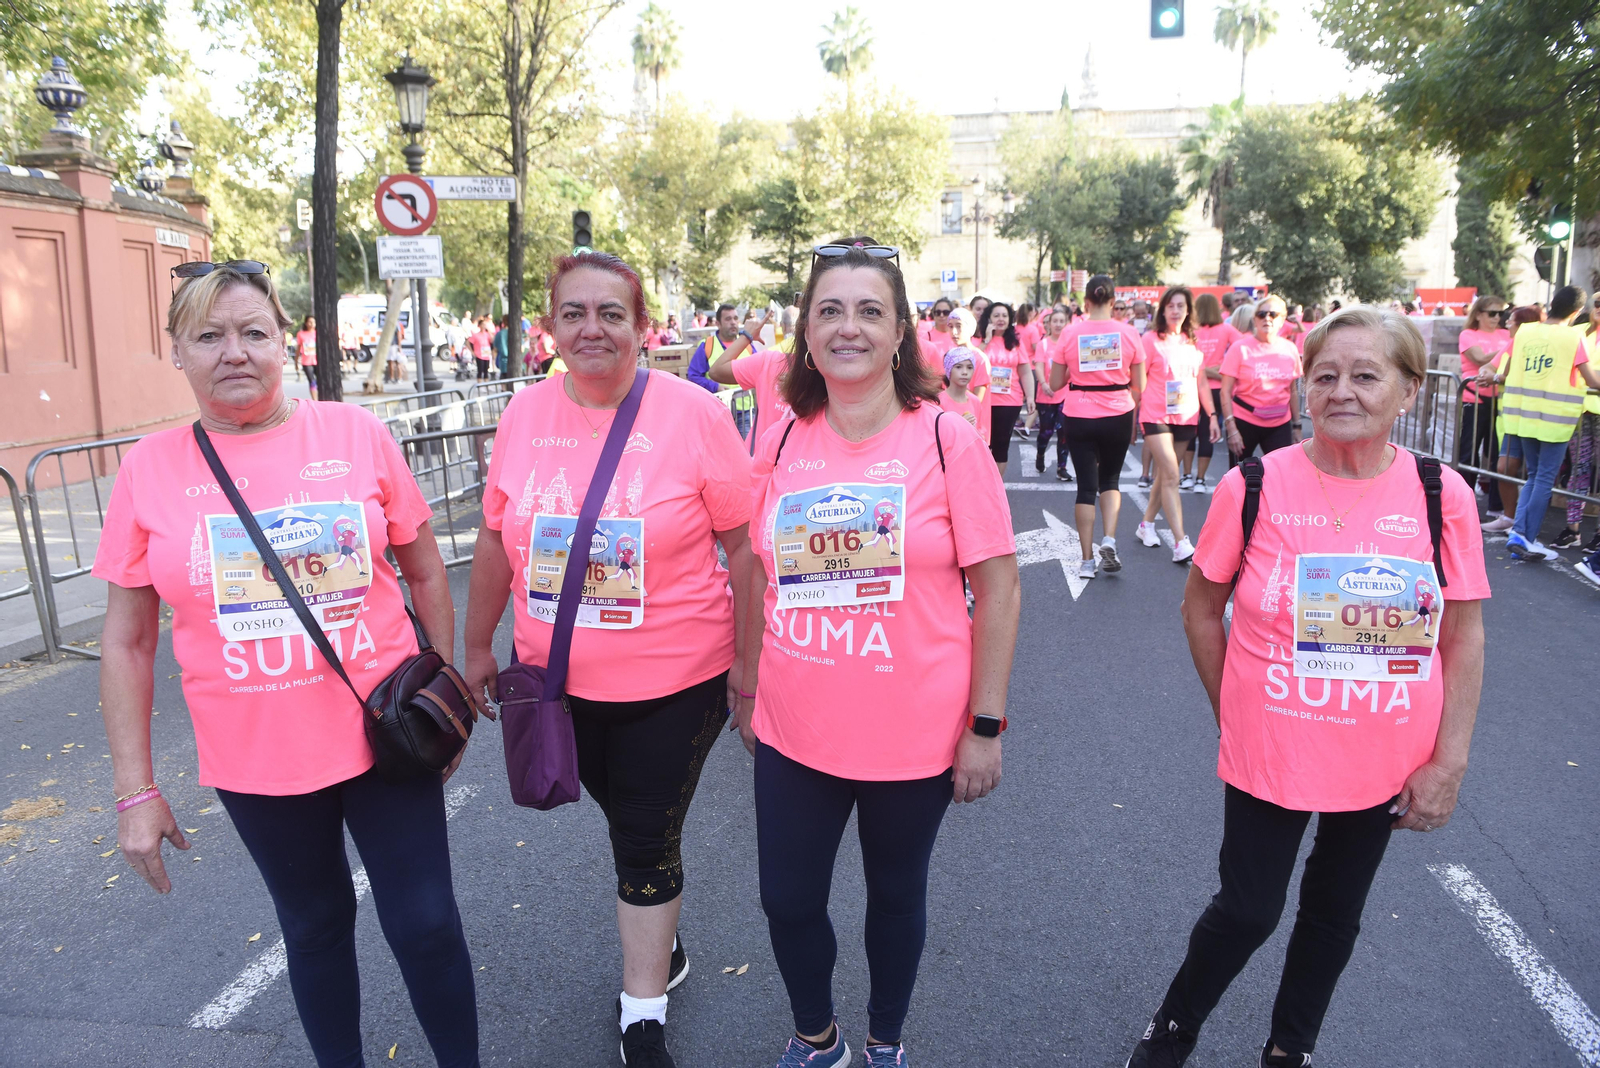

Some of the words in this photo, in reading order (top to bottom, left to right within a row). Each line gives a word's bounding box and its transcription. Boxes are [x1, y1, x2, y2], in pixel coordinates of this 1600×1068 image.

[481, 178, 510, 186] HOTEL
[944, 271, 954, 282] P
[1525, 355, 1553, 373] Life
[532, 436, 578, 448] OYSHO
[304, 465, 349, 478] ASTURIANA
[186, 477, 249, 497] OYSO
[783, 508, 802, 516] SUMA
[810, 507, 861, 519] ASTURIANA
[1271, 513, 1327, 527] OYSHO
[1378, 523, 1417, 534] ASTURIAN
[269, 528, 319, 545] STURIANA
[809, 529, 861, 555] 016
[824, 557, 850, 570] 2915
[587, 562, 605, 582] 16
[801, 573, 831, 583] CARRERA
[842, 571, 851, 579] LA
[852, 569, 875, 578] MUJER
[1306, 572, 1331, 580] SUMA
[582, 585, 596, 595] 911
[866, 585, 886, 593] Santander
[1343, 577, 1403, 591] ASTURIANA
[251, 599, 290, 611] CARRERA
[304, 596, 316, 605] LA
[317, 592, 343, 603] MUJER
[581, 596, 588, 604] DE
[588, 597, 595, 605] LA
[596, 598, 617, 606] MUJER
[787, 589, 825, 601] OYSHO
[536, 606, 557, 617] OYS
[1341, 604, 1402, 629] 016
[233, 618, 284, 632] OYSHO
[770, 608, 893, 658] SUMA
[1355, 632, 1387, 644] 2914
[1325, 644, 1361, 653] CARRERA
[1363, 646, 1374, 654] DE
[1375, 647, 1384, 655] LA
[1385, 647, 1407, 655] MUJER
[792, 651, 800, 659] DE
[801, 653, 808, 661] LA
[810, 656, 835, 666] MUJER
[1307, 660, 1354, 671] OYSHO
[229, 685, 264, 694] CARRERA
[265, 684, 278, 692] DE
[280, 682, 291, 690] LA
[293, 675, 324, 688] MUJER
[1264, 663, 1411, 713] SUMA
[1264, 703, 1298, 718] CARRERA
[1301, 711, 1312, 720] DE
[1314, 713, 1324, 721] LA
[1327, 715, 1357, 725] MUJER
